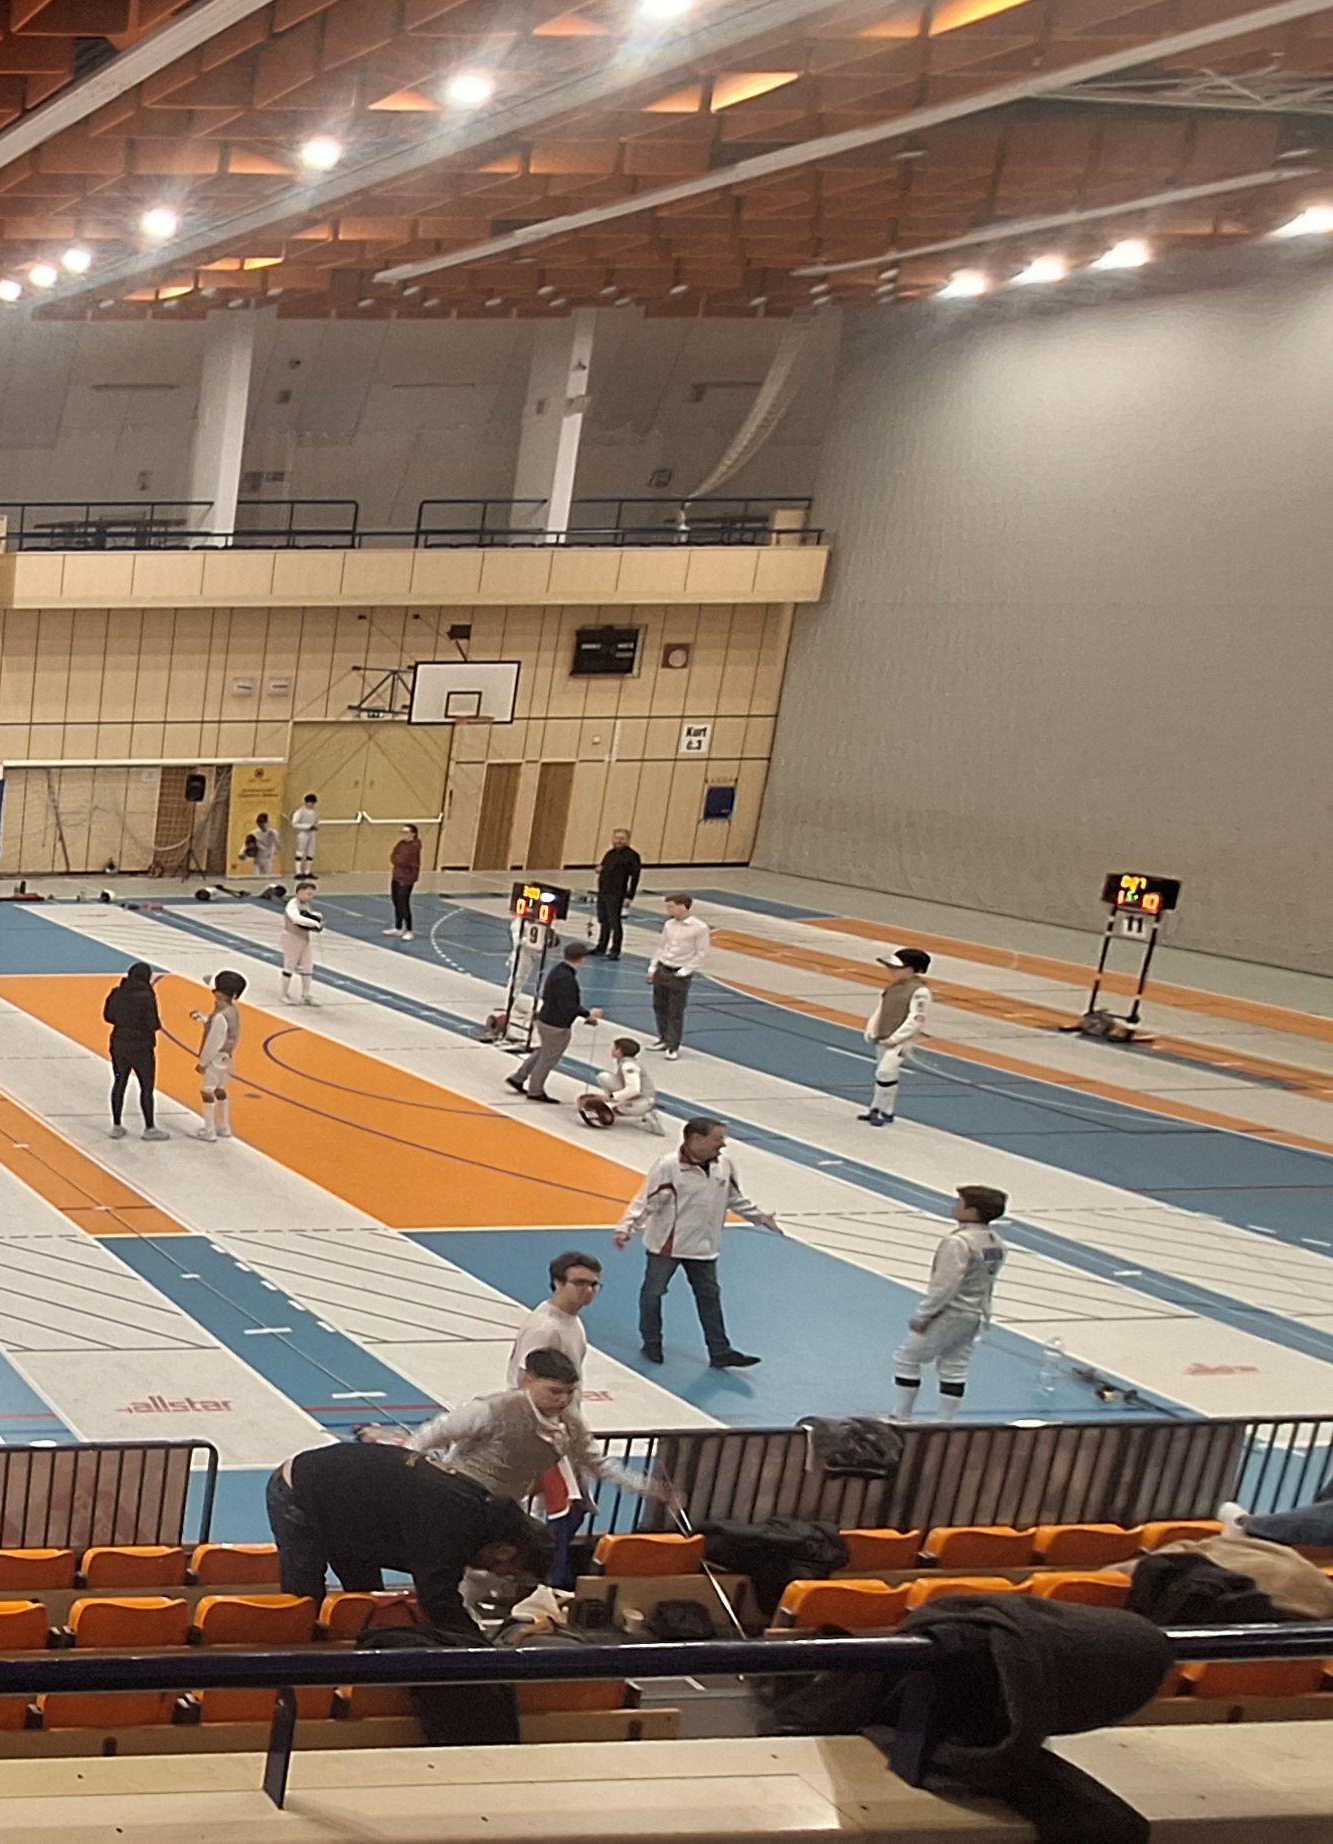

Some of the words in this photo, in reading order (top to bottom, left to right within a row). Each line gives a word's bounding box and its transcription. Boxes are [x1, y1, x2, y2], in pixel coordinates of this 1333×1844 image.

[686, 727, 708, 738] Kurt
[516, 898, 526, 915] 0
[539, 904, 549, 921] 0
[1127, 915, 1144, 934] 11
[529, 926, 539, 944] 9
[132, 1395, 232, 1414] allstar
